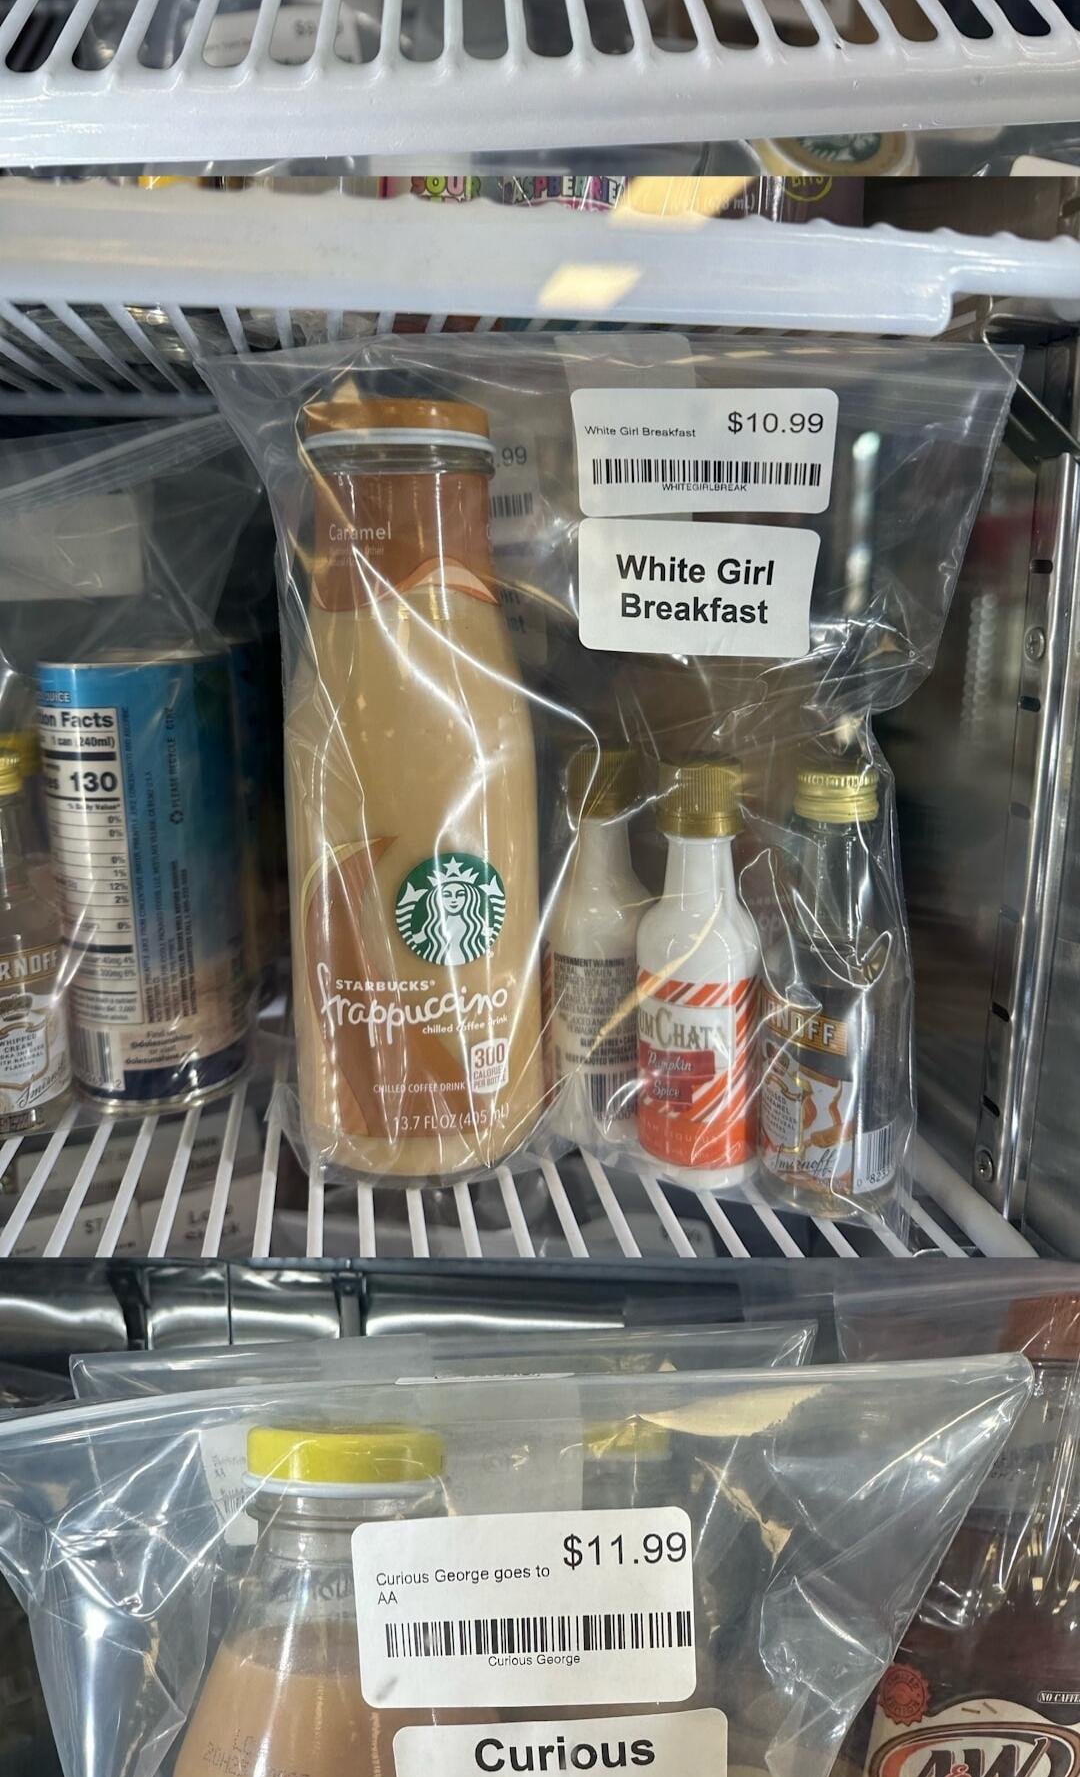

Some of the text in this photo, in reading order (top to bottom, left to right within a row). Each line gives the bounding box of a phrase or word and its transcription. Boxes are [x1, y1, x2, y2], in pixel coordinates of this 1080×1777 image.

[584, 425, 696, 438] White Girl Breakfast
[727, 411, 824, 435] $10.99
[661, 483, 748, 492] WHITEGIRLBREAK
[328, 523, 392, 542] Caramel
[616, 554, 775, 586] White Girl
[621, 593, 768, 624] Breakfast
[61, 712, 114, 729] Facts
[70, 771, 118, 793] 130
[335, 979, 431, 992] STARBUCKS
[474, 1043, 506, 1069] 300
[648, 1049, 692, 1073] Pumpkin
[373, 1081, 466, 1094] CHILLED COFFEE DRINK
[653, 1080, 681, 1099] Spice
[393, 1109, 458, 1131] 13.7 FL OZ
[563, 1531, 687, 1571] $11.99
[376, 1565, 551, 1587] Curious George goes to
[377, 1591, 399, 1605] AA
[474, 1736, 656, 1773] Curious
